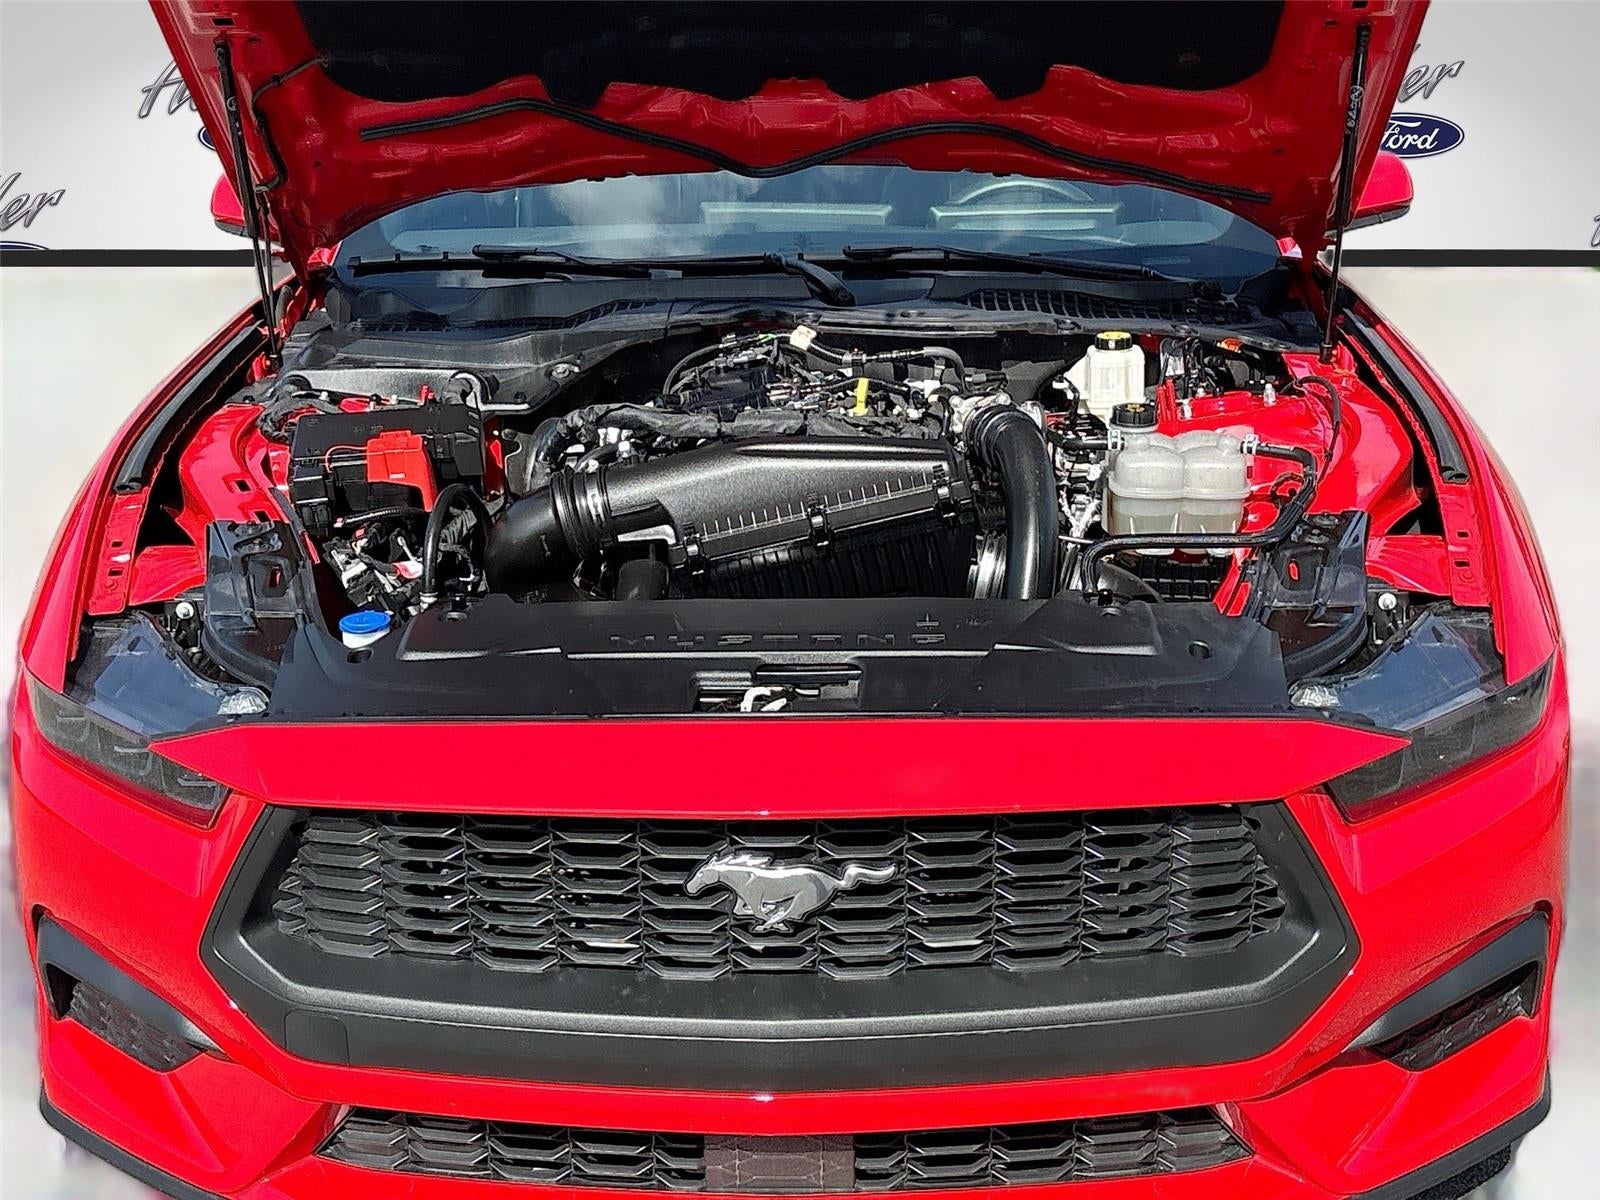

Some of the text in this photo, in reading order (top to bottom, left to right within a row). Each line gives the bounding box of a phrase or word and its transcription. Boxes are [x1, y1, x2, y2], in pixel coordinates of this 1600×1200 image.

[1398, 61, 1464, 103] er
[1380, 120, 1440, 149] Ford
[609, 634, 947, 650] MUSTANG
